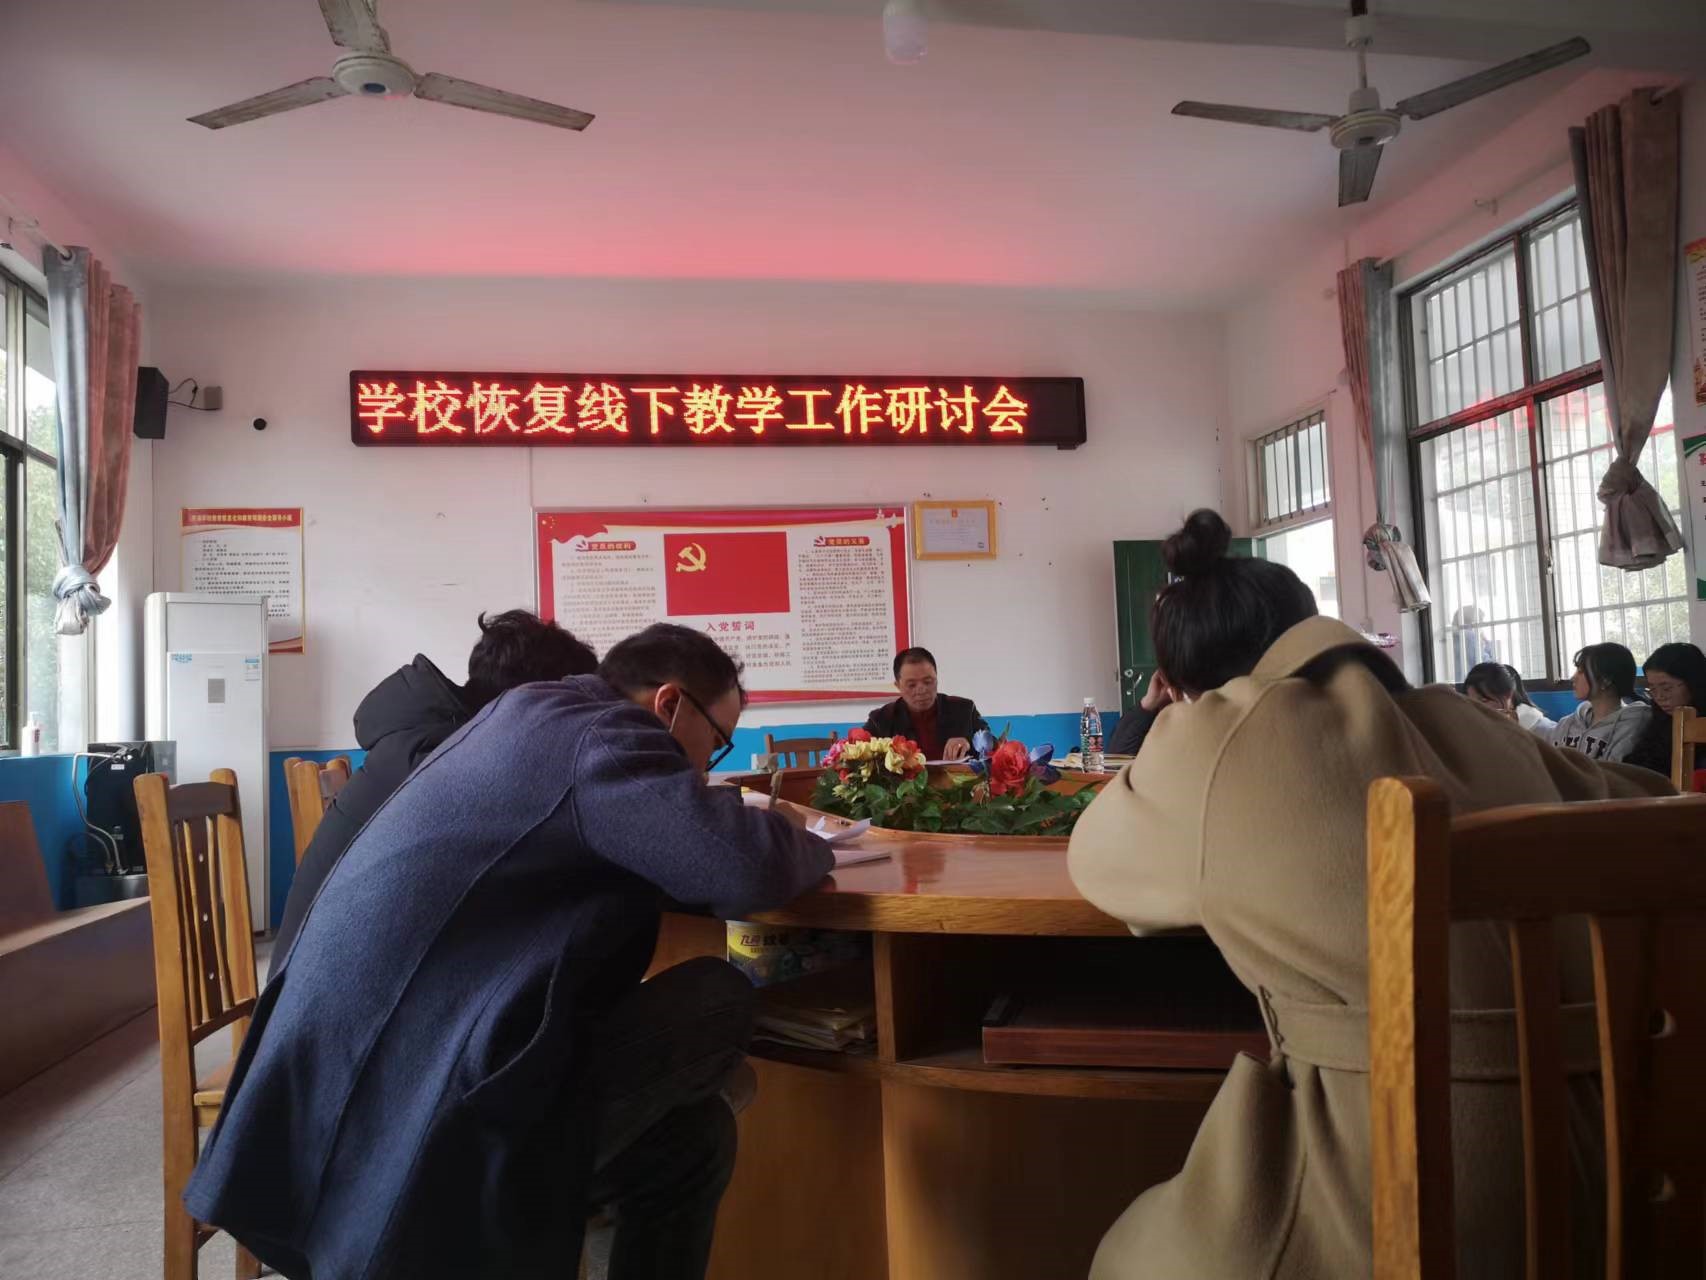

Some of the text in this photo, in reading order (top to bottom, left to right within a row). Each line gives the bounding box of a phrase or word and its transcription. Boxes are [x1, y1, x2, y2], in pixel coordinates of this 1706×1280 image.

[357, 380, 1029, 434] 学校恢复线下教学工作研讨会
[706, 620, 755, 632] 入党誓词
